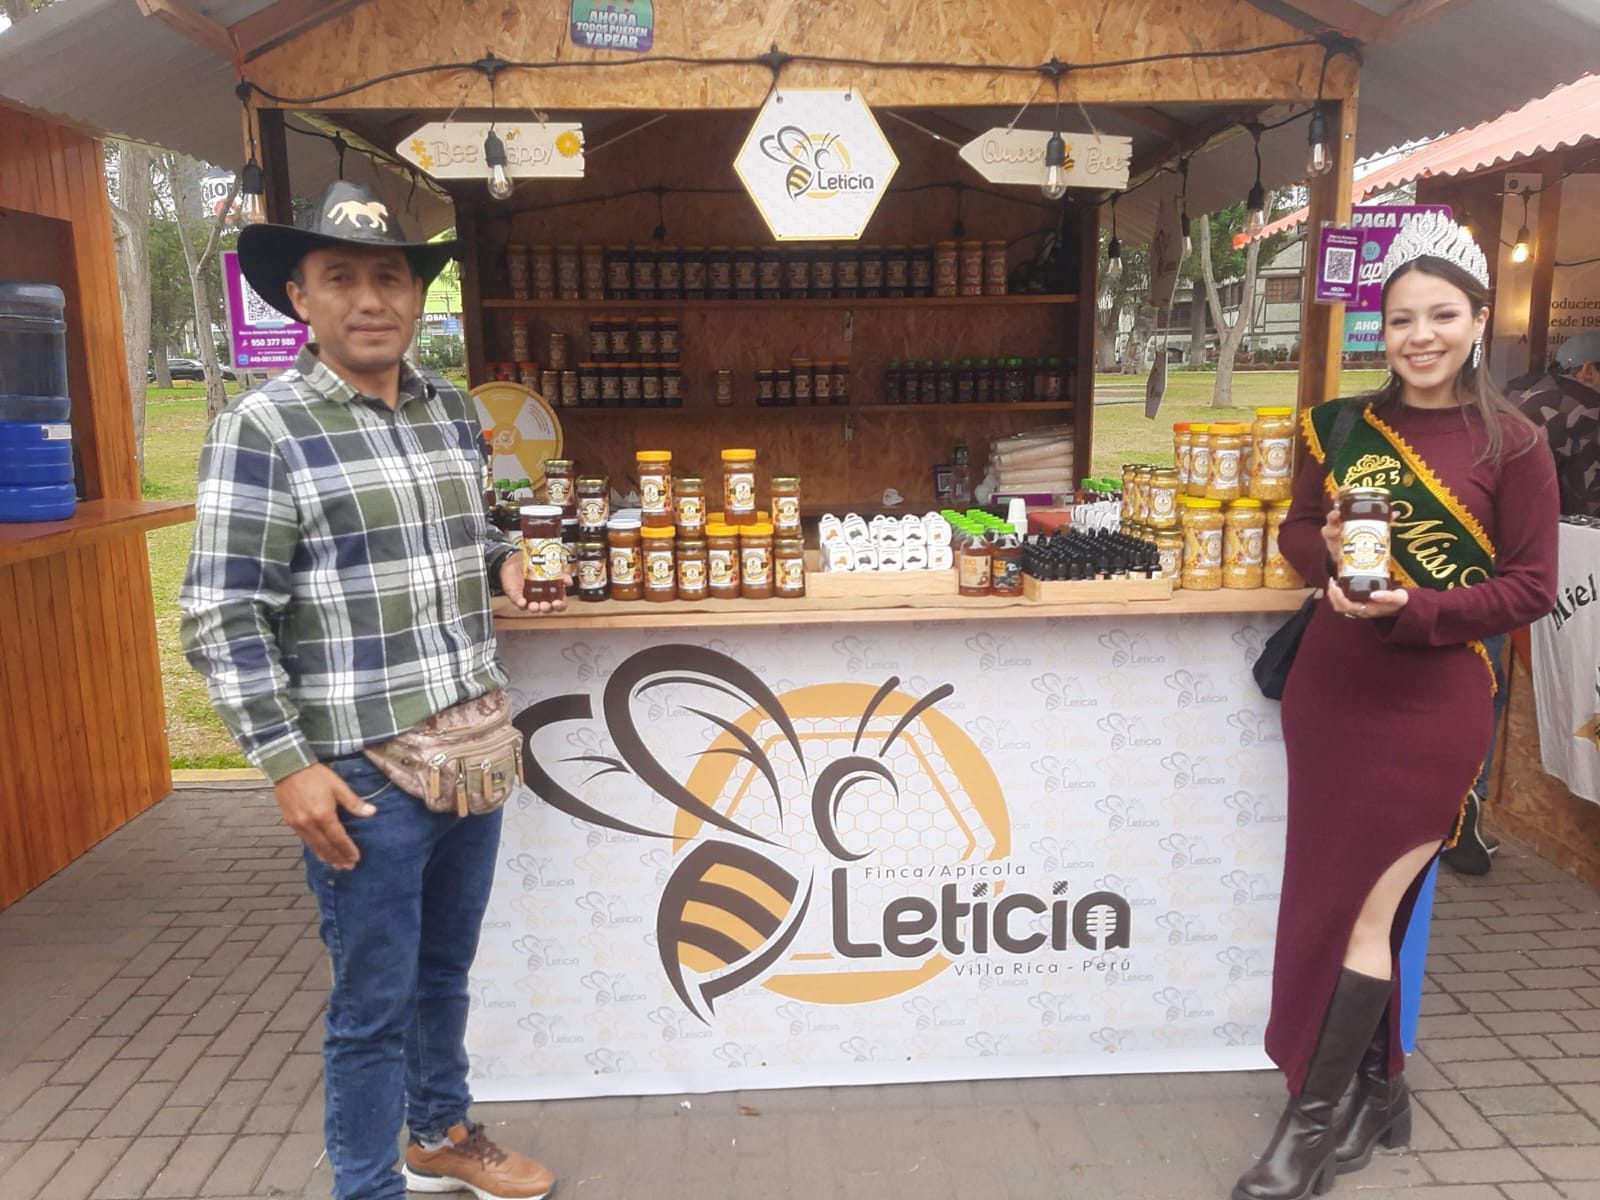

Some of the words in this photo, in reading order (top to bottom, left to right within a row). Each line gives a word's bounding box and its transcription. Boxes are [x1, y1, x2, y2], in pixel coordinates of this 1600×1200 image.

[588, 11, 637, 26] AHORA
[576, 22, 609, 34] TODOS
[609, 25, 648, 37] PUEDEN
[586, 32, 639, 48] YAPEAR
[429, 139, 478, 168] Bee
[504, 143, 554, 168] appy
[1085, 146, 1126, 175] Bee
[817, 170, 875, 190] Leticia
[1351, 212, 1397, 228] PAGA
[1354, 320, 1382, 331] AHO
[1550, 315, 1578, 328] esde
[1390, 499, 1459, 579] Miss
[831, 866, 1132, 959] Leticia
[954, 961, 1005, 977] Villa
[1013, 961, 1059, 975] Rica
[1082, 958, 1131, 973] Perú
